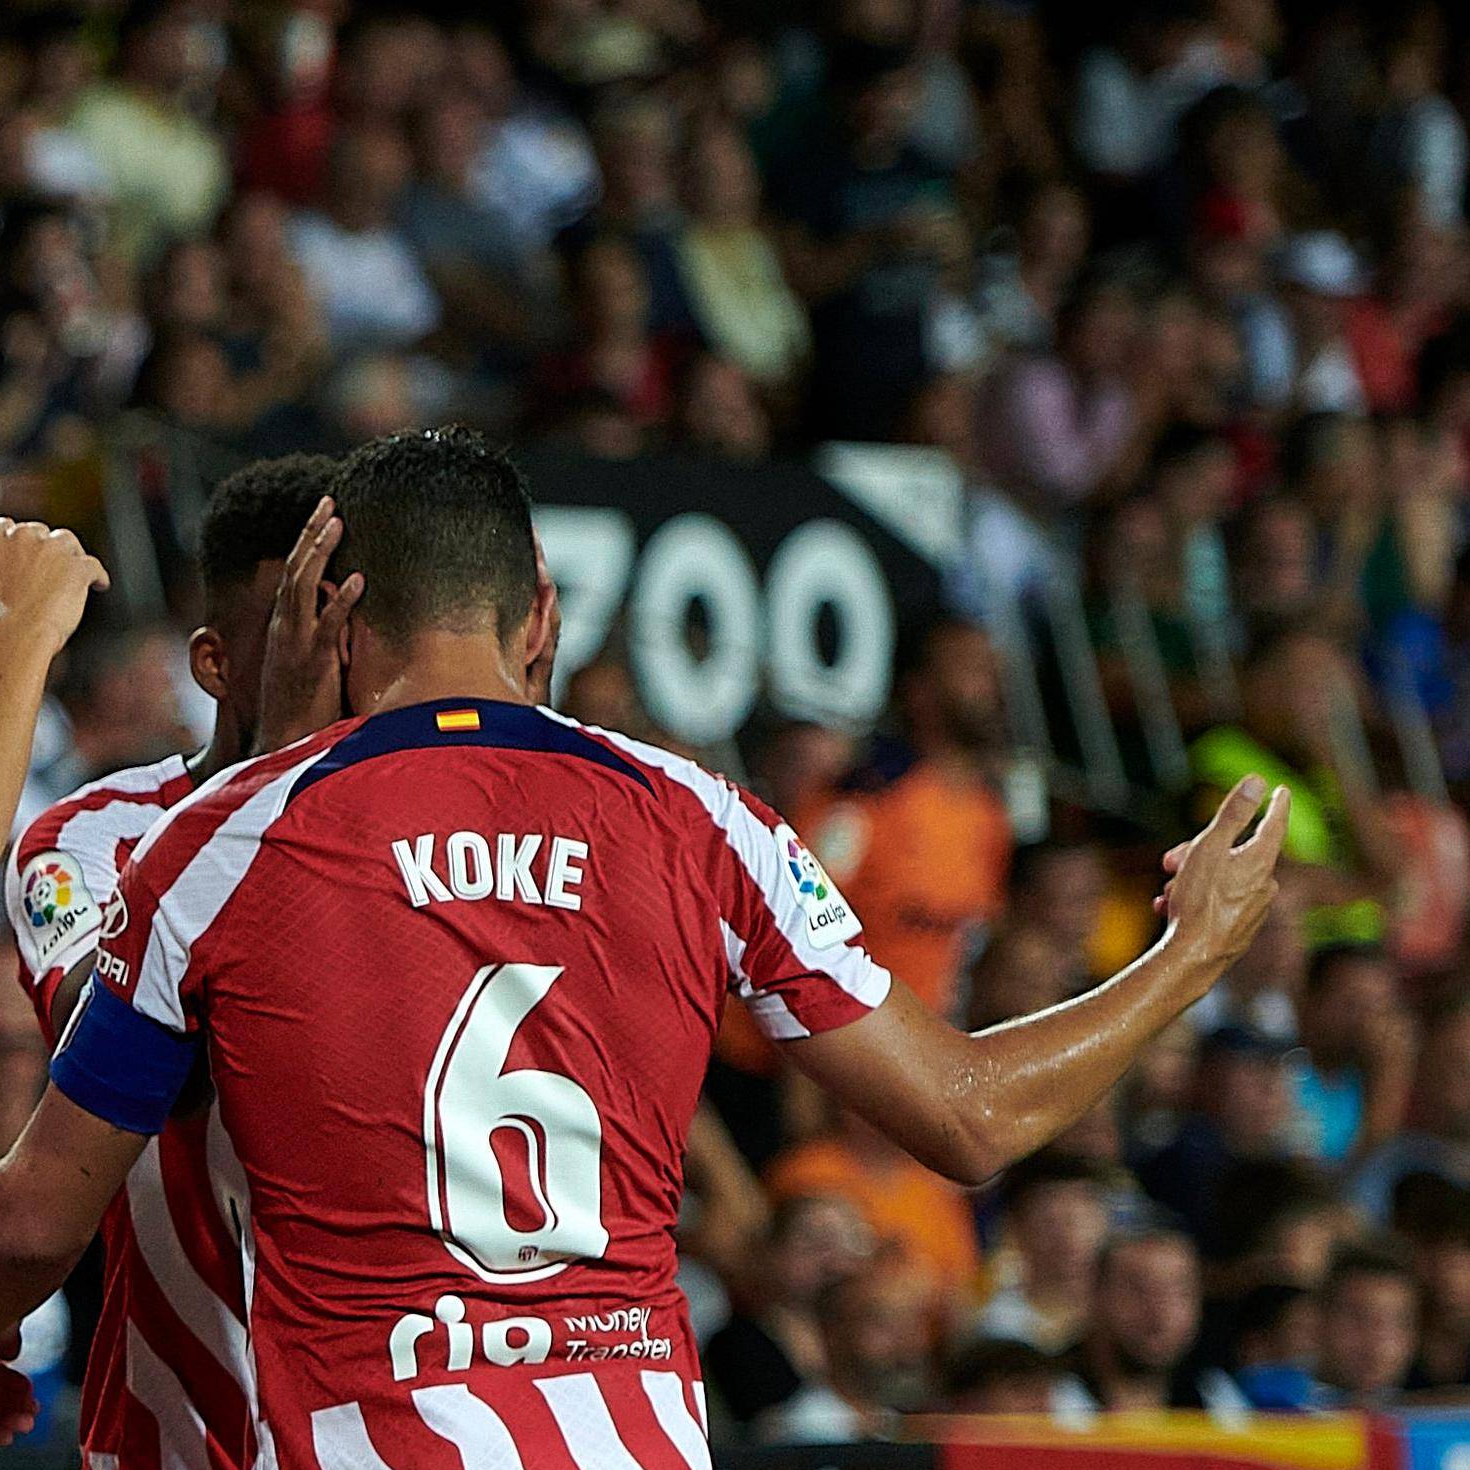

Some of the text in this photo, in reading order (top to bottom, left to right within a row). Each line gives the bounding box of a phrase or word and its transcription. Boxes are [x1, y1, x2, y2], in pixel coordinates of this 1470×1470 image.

[391, 829, 590, 912] KOKE
[423, 961, 610, 1285] 6
[389, 1294, 553, 1382] ria
